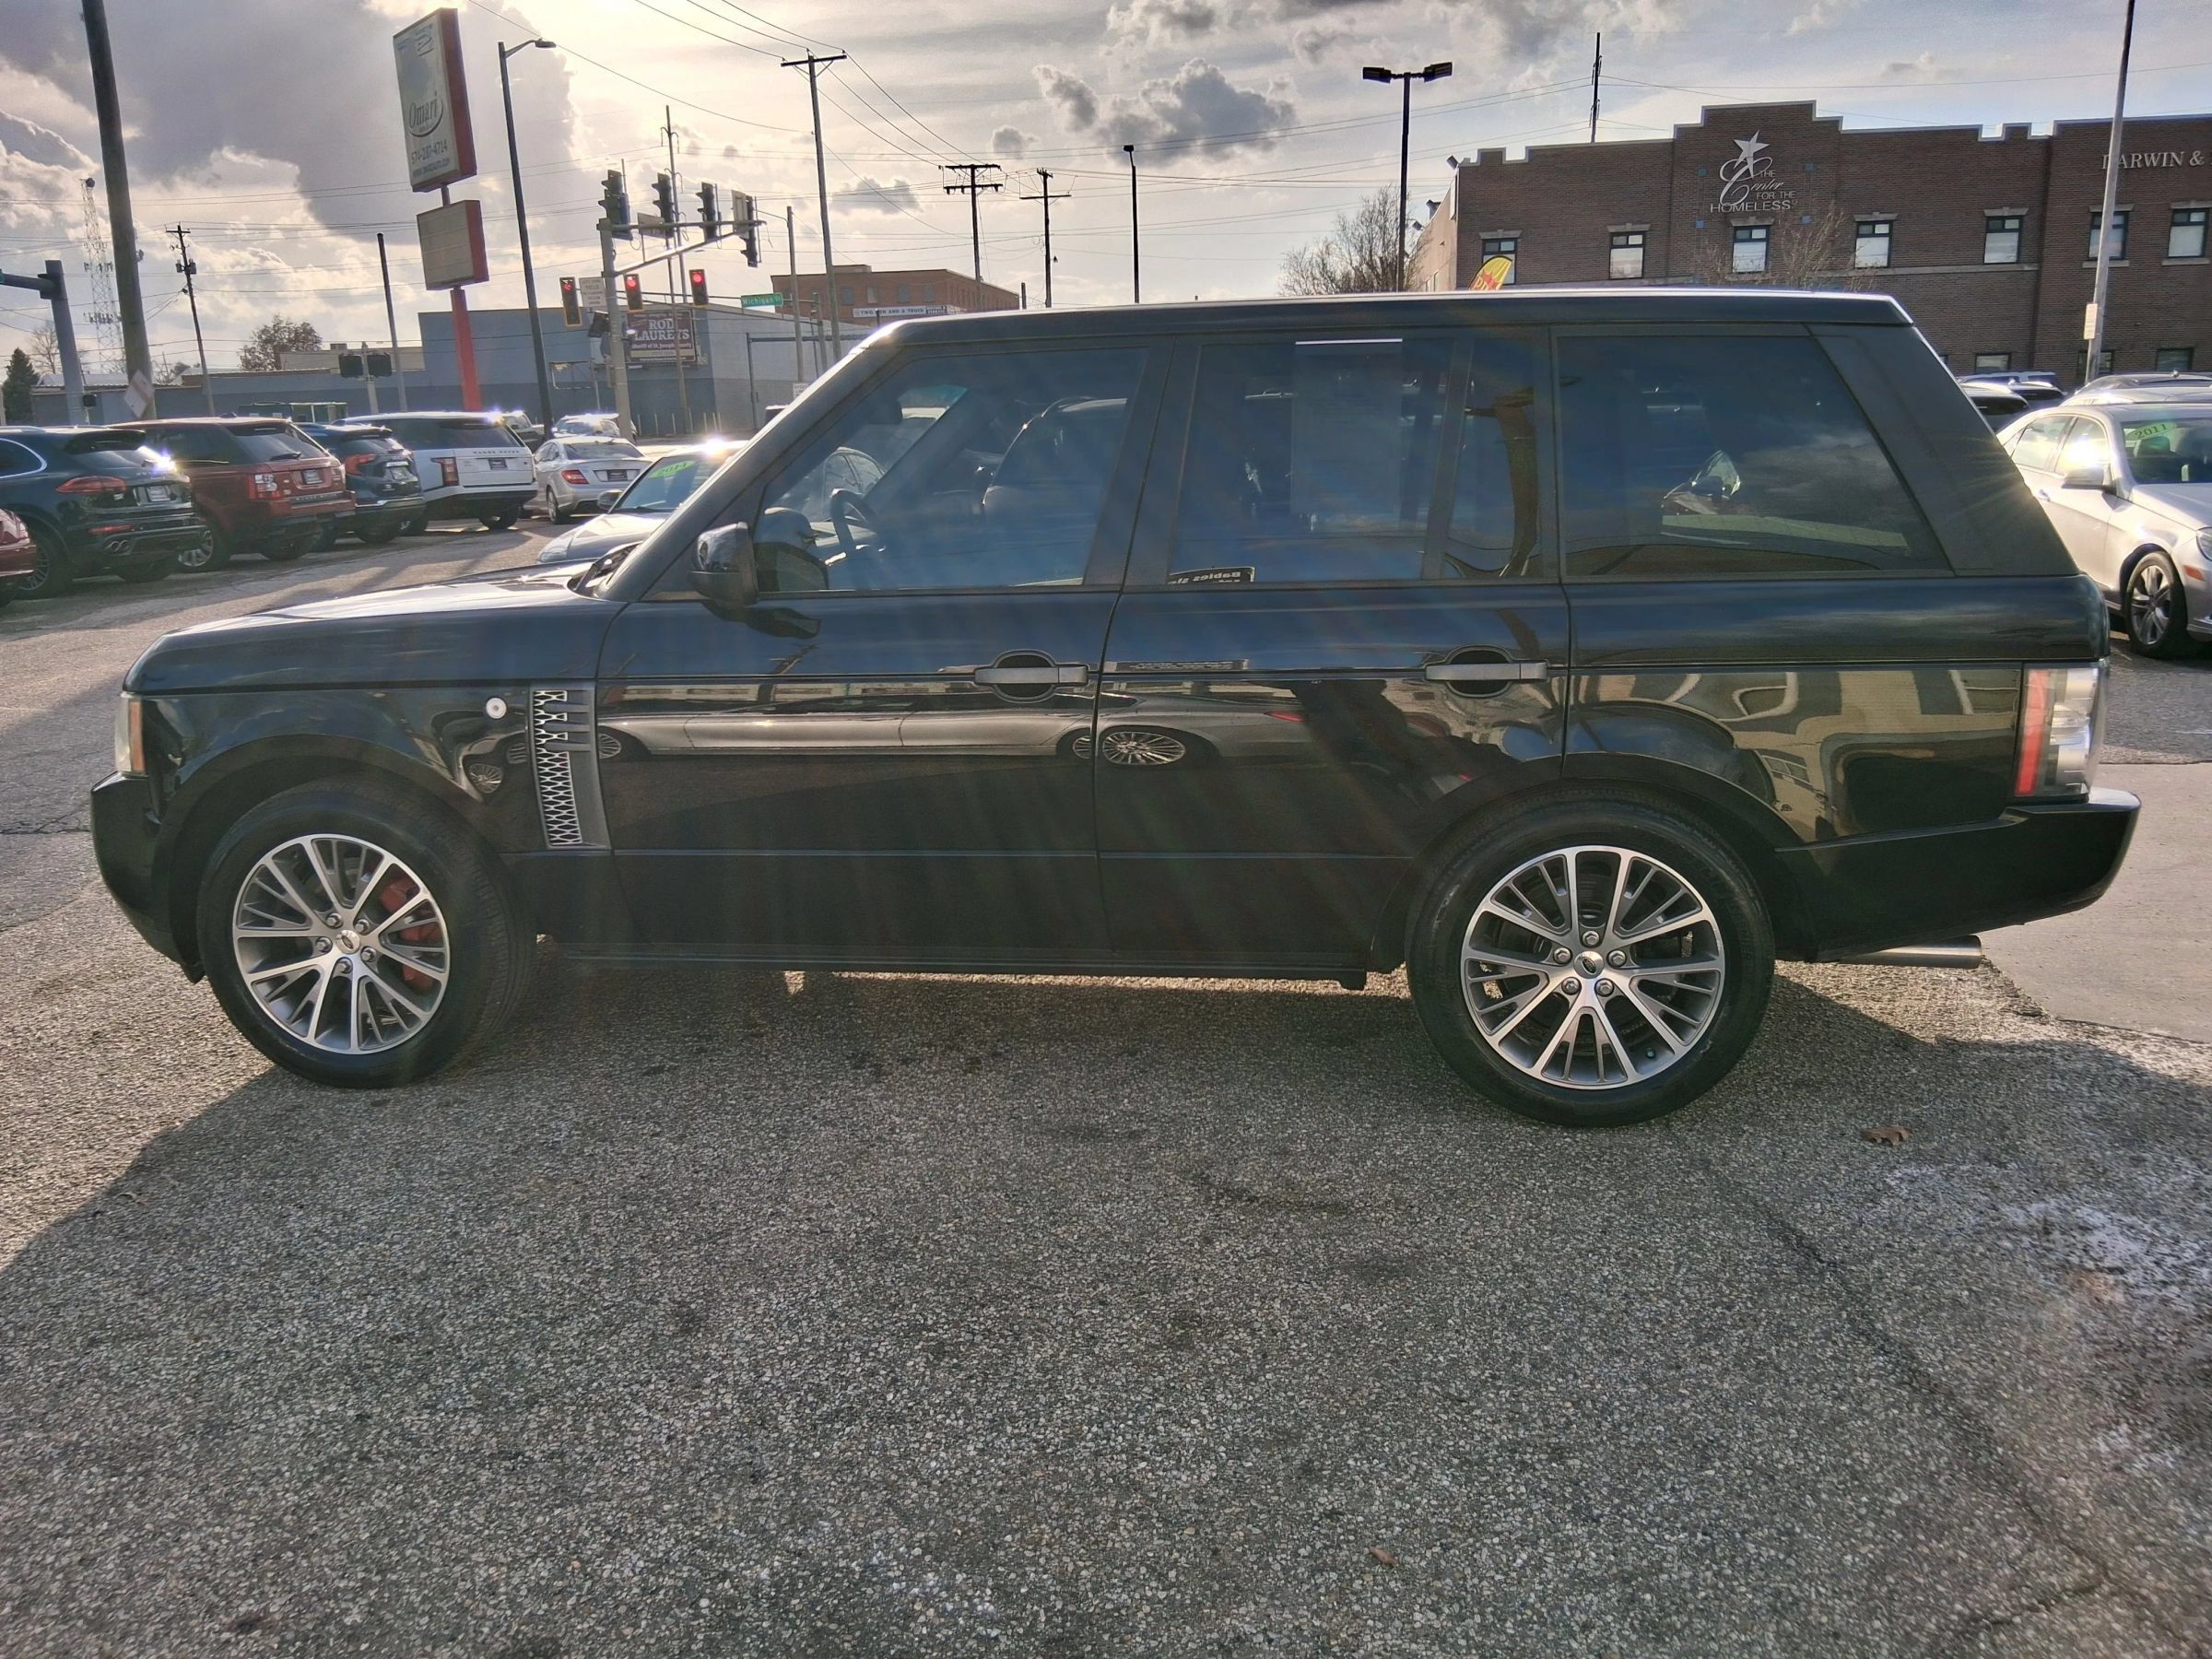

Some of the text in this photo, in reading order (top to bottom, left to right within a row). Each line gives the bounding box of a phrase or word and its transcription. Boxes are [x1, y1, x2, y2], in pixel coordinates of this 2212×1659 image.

[408, 90, 438, 129] Omari
[2189, 150, 2205, 166] &
[1759, 170, 1776, 178] THE
[1719, 157, 1784, 206] Center
[1756, 190, 1796, 200] FOR THE
[1710, 200, 1792, 213] HOMELESS
[742, 296, 774, 305] Michigan
[649, 319, 675, 330] ROD
[2134, 424, 2169, 439] 2011
